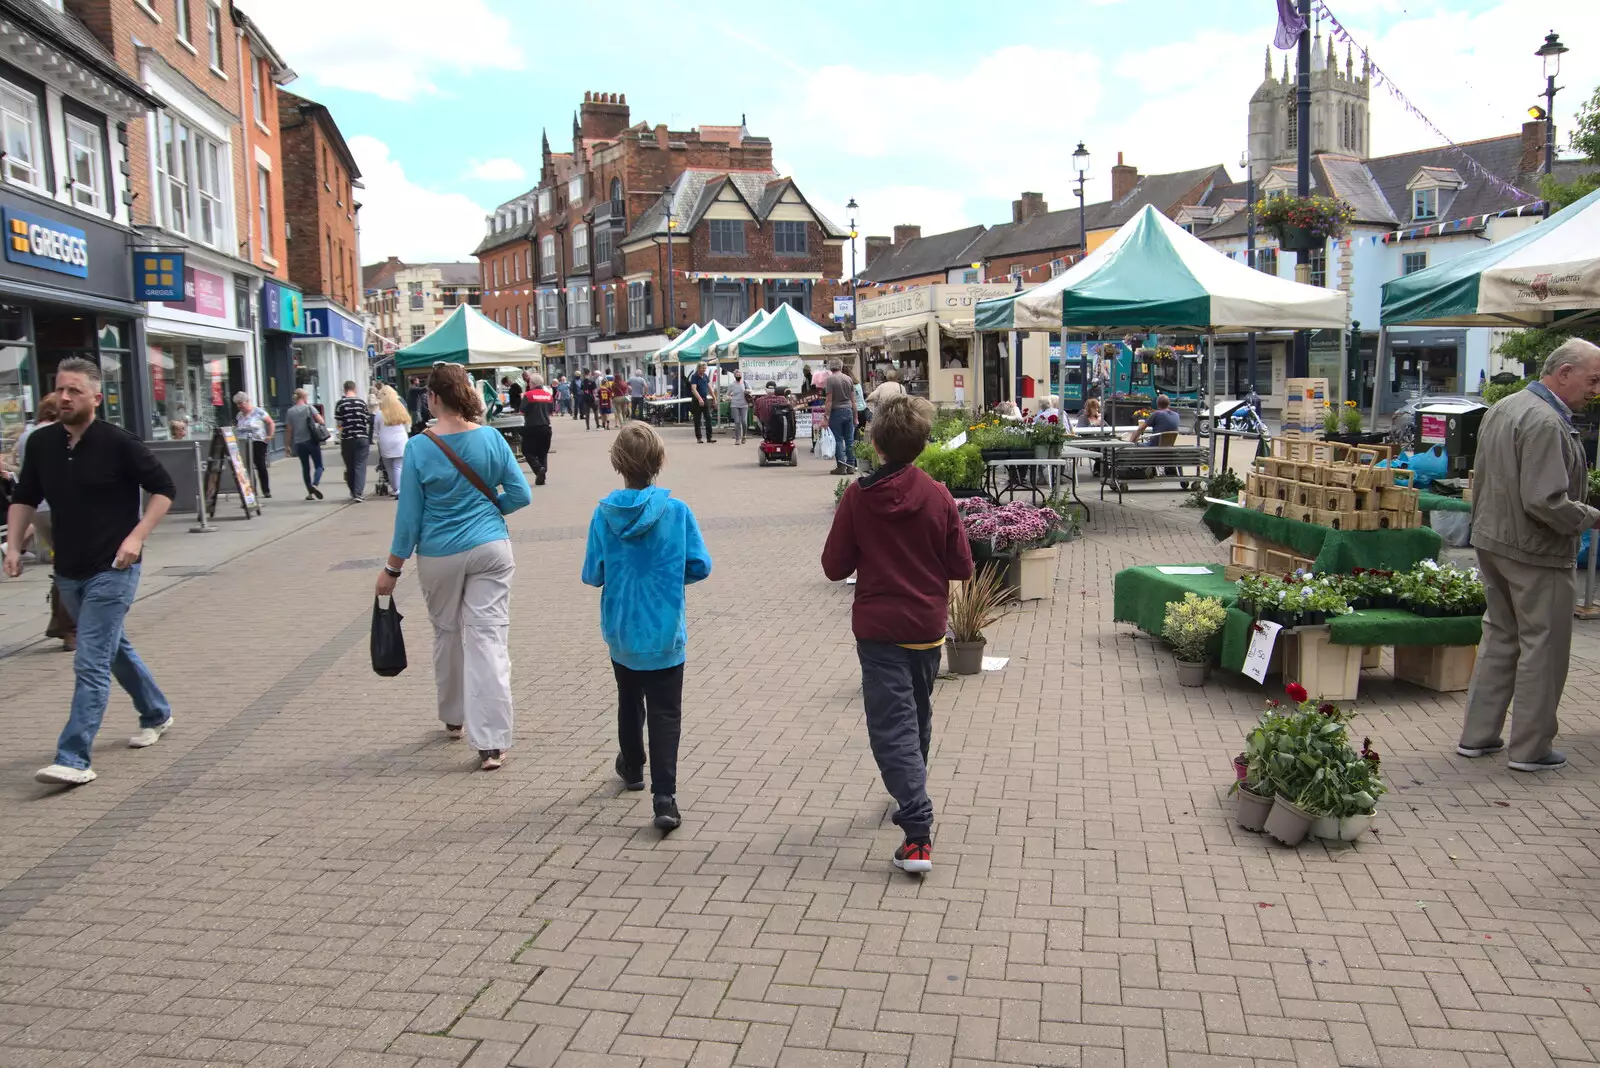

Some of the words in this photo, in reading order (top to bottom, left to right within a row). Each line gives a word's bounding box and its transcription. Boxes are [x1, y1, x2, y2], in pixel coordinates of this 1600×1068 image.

[29, 223, 88, 267] GREGGS
[144, 289, 174, 297] GREGGS
[877, 298, 912, 316] CUISINE
